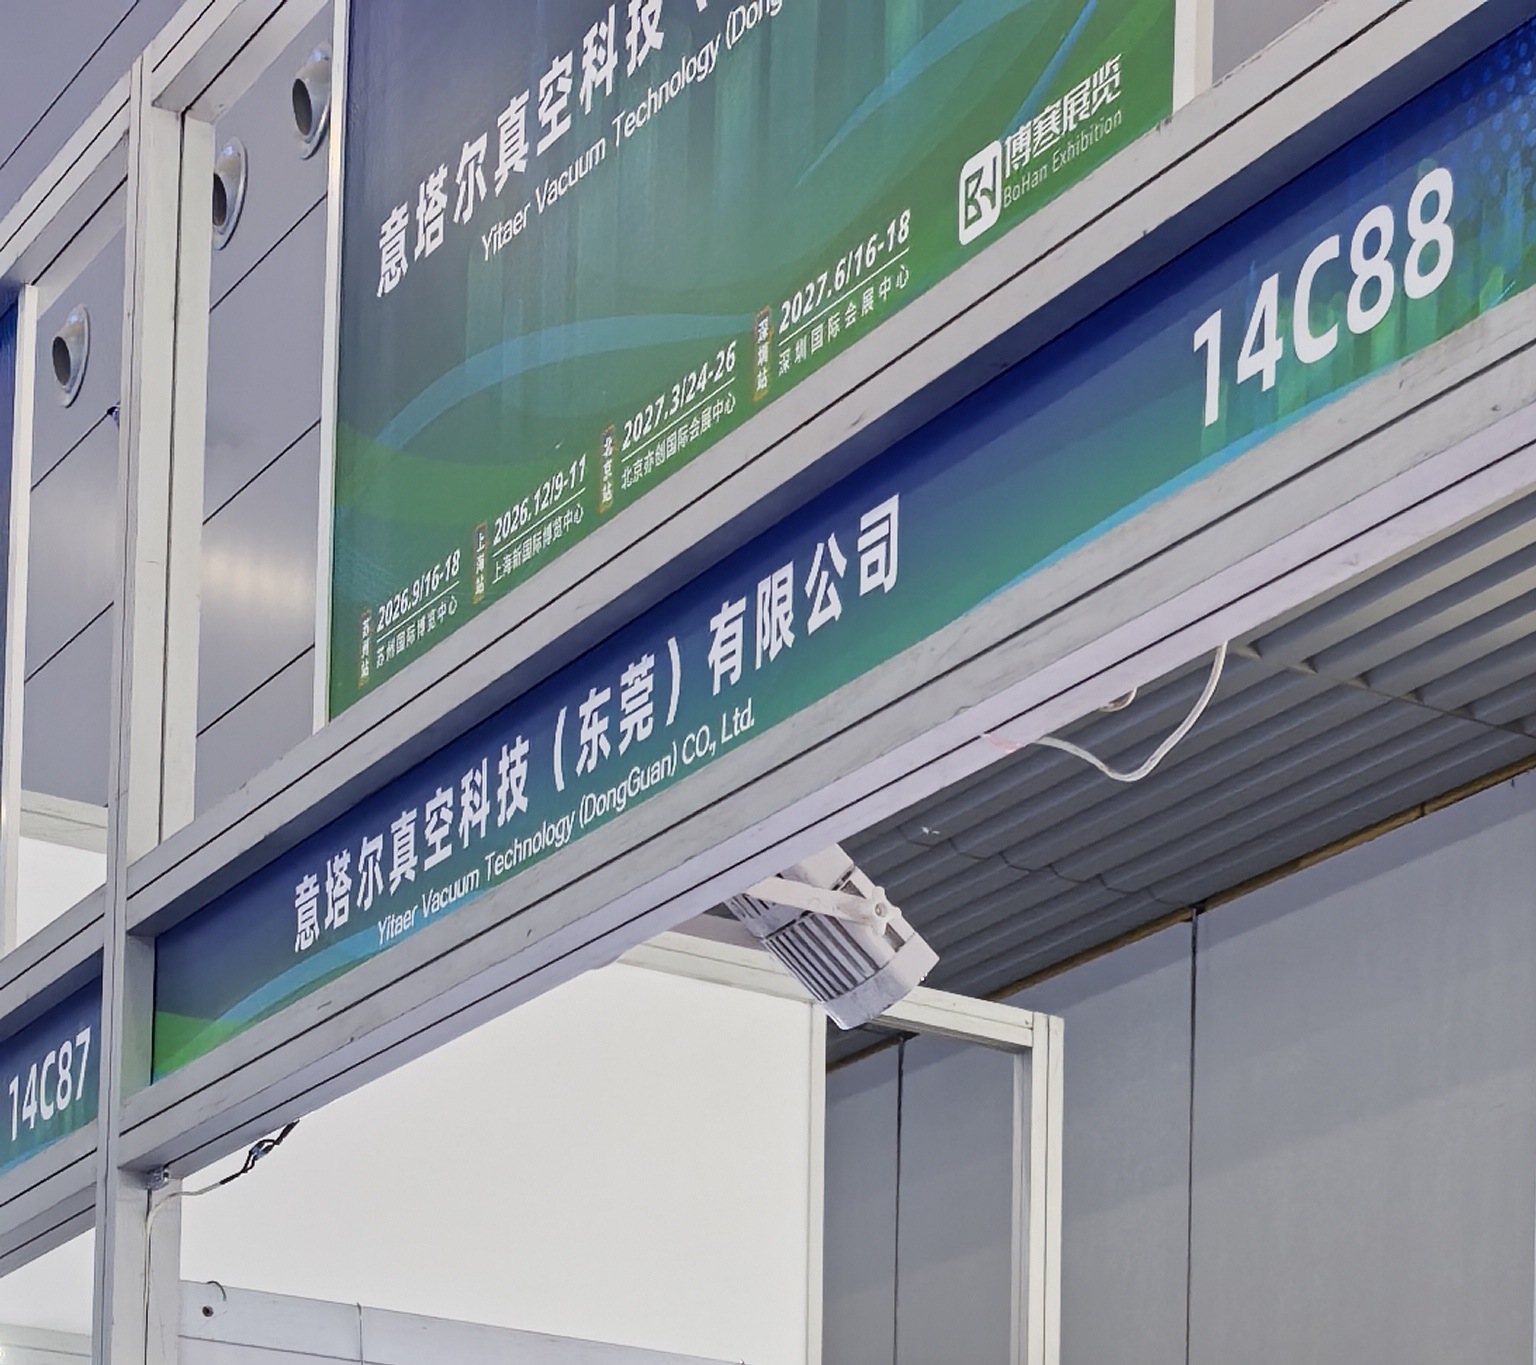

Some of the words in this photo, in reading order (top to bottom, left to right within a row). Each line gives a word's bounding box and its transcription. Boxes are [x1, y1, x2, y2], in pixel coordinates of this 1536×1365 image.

[377, 0, 708, 297] 意塔尔真空科技
[481, 202, 532, 261] Yitaer
[535, 136, 606, 215] Vacuum
[611, 33, 721, 147] Technology
[1003, 164, 1048, 208] BoHan
[1052, 110, 1122, 172] Exhibition
[779, 208, 911, 334] 2027.6/16-18
[779, 264, 909, 376] 深圳国际会展中心
[1193, 167, 1454, 427] 14C88
[621, 340, 737, 451] 2027.3/24-26
[621, 393, 736, 490] 北京亦创国际会展中心
[492, 454, 586, 546] 2026.12/9-11
[492, 503, 584, 584] 上海新国际博览中心
[376, 549, 461, 632] 2026.9/16-18
[376, 596, 458, 668] 苏州国际博览中心
[294, 493, 901, 952] 意塔尔真空科技（东莞）有限公司
[377, 906, 418, 949] Yitaer
[422, 867, 480, 916] Vacuum
[485, 809, 576, 878] Technology
[579, 739, 677, 832] (DongGuan)
[8, 1026, 92, 1141] 14C87
